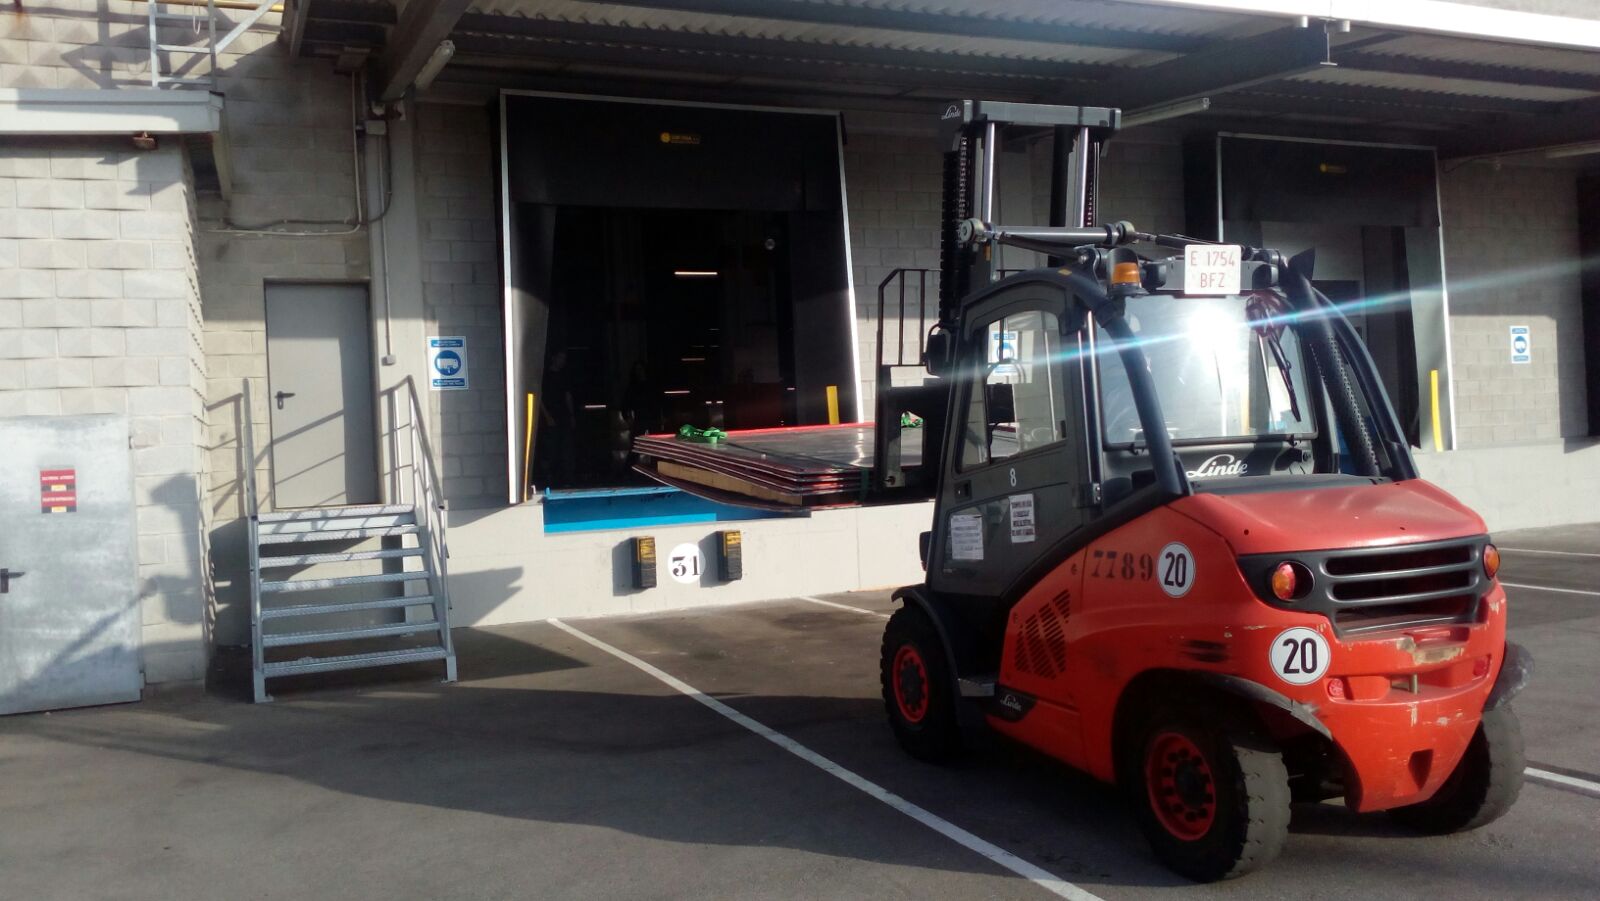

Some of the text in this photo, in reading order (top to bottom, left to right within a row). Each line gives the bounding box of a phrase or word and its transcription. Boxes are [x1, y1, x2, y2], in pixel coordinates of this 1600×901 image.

[1190, 250, 1235, 267] E 1754
[1200, 272, 1226, 288] BFZ
[1009, 467, 1017, 487] 8
[1185, 453, 1248, 478] Linde
[672, 555, 701, 577] 31
[1091, 550, 1154, 580] 7789
[1164, 551, 1187, 588] 20
[1282, 637, 1318, 674] 20
